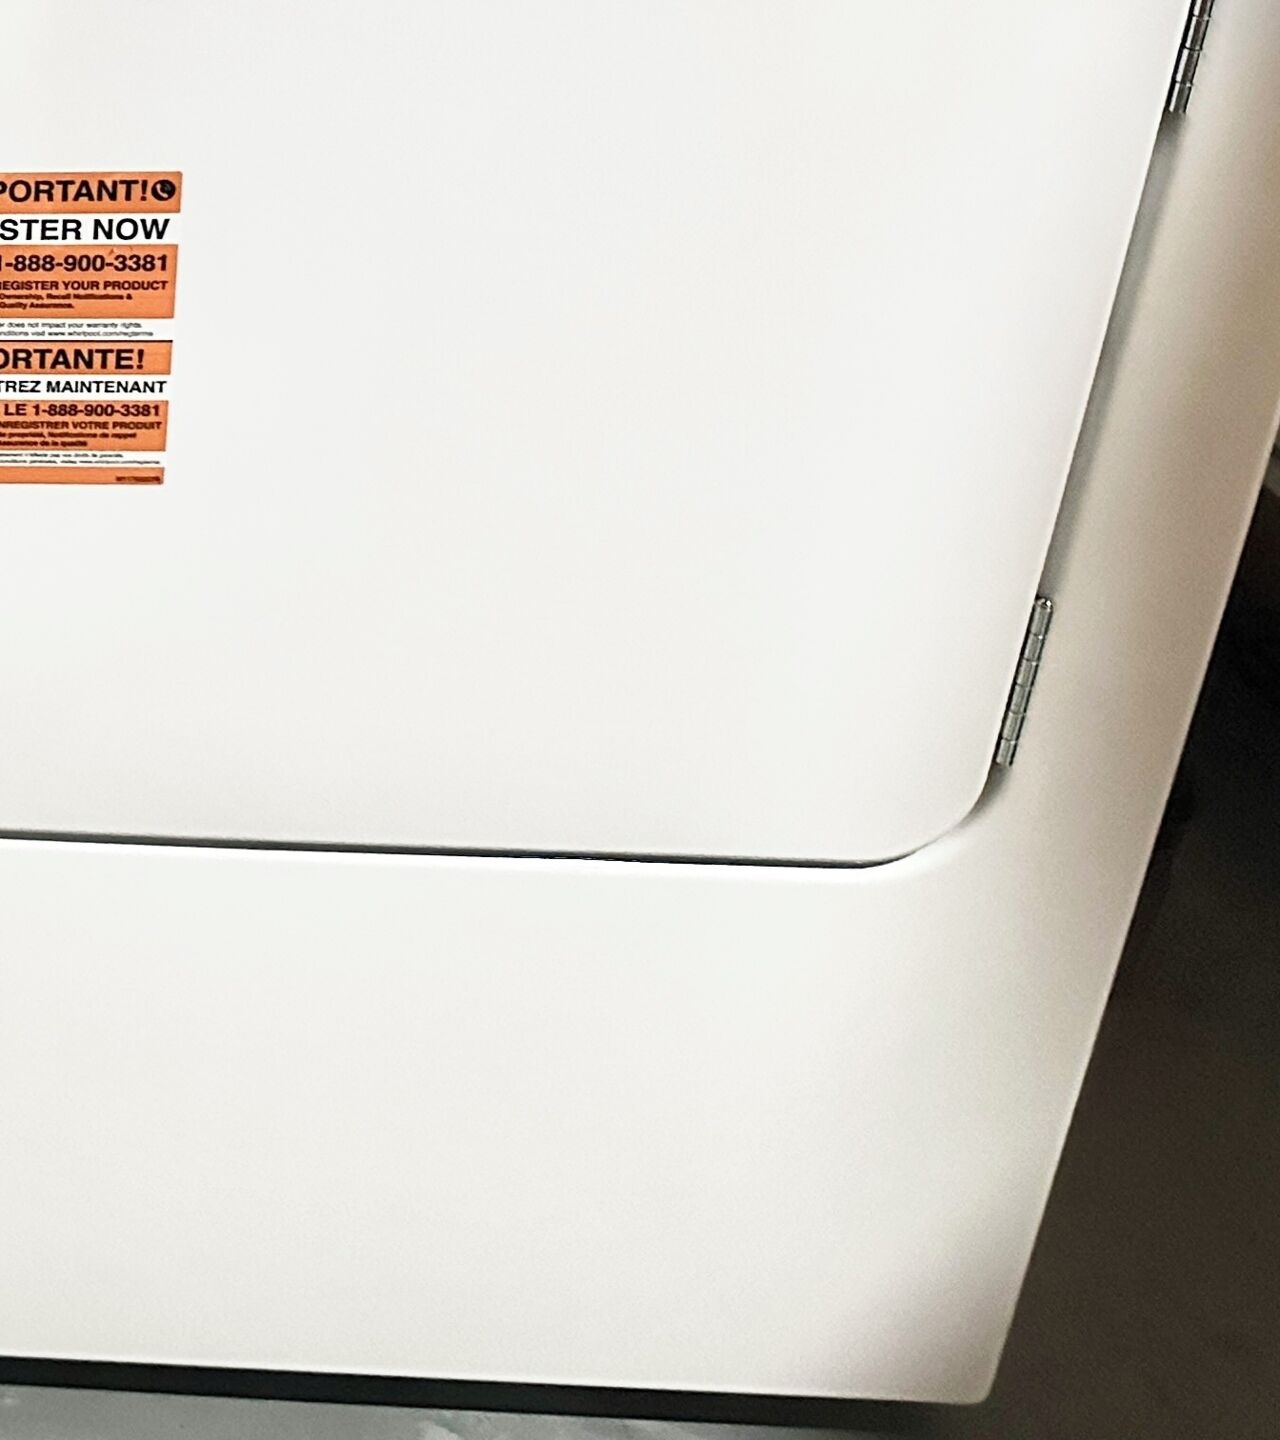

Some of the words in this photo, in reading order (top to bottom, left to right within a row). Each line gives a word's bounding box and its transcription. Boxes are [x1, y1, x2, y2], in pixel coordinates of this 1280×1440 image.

[92, 218, 171, 240] NOW
[62, 280, 100, 291] YOUR
[103, 280, 169, 291] PRODUCT
[46, 293, 71, 301] Recall
[0, 302, 28, 310] Quality
[27, 321, 40, 329] not
[41, 321, 66, 329] impact
[68, 321, 84, 329] your
[46, 380, 167, 394] MAINTENANT
[4, 403, 27, 417] LE
[32, 403, 160, 417] 1-888-900-3381
[71, 421, 110, 430] VOTRE
[112, 421, 162, 430] PRODUIT
